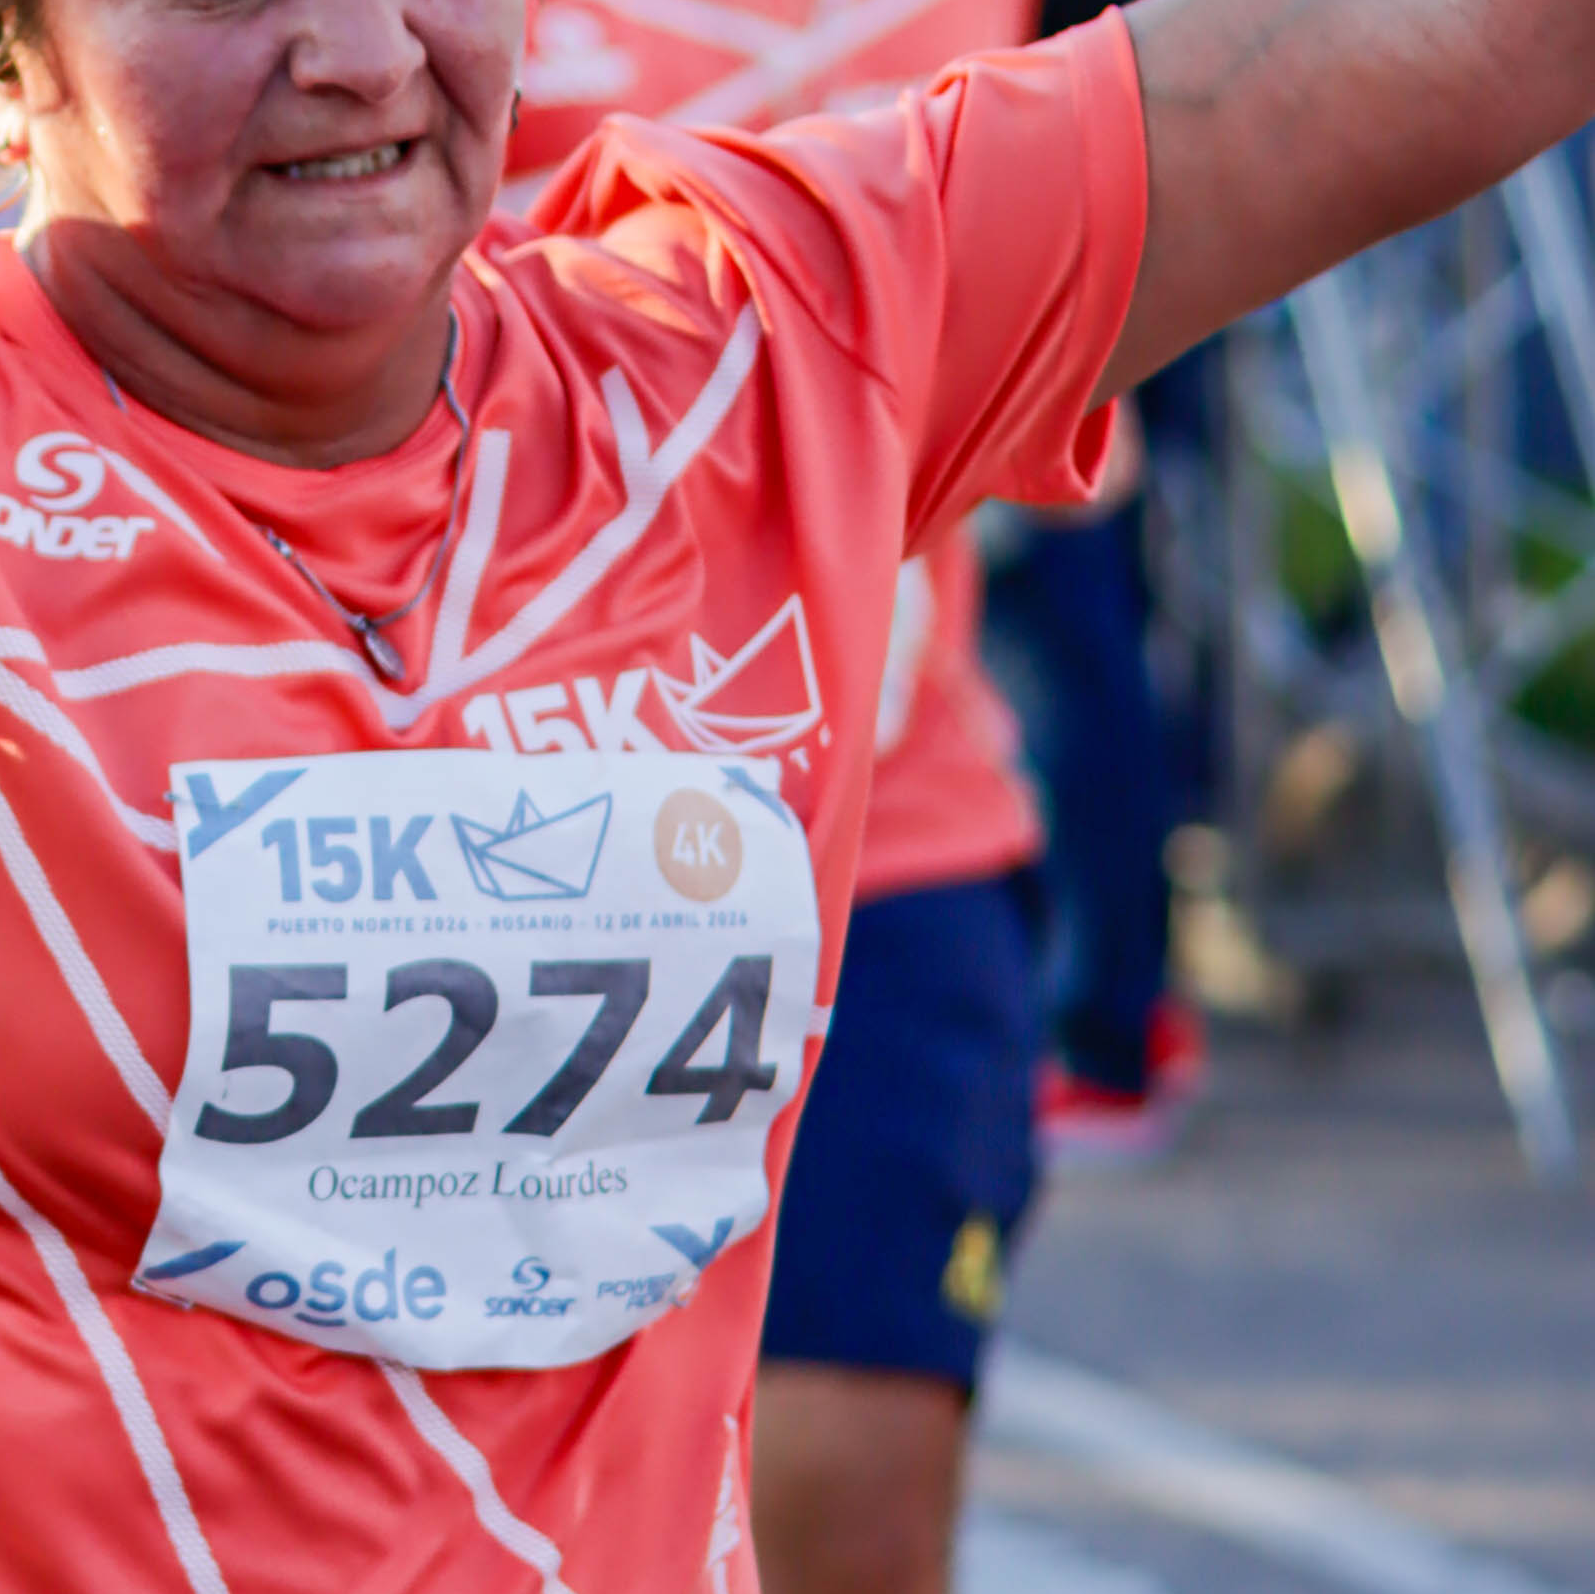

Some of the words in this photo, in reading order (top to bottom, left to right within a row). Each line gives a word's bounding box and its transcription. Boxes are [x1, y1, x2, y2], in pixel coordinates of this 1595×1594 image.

[462, 667, 671, 753] 15K
[261, 815, 438, 902] 15K
[671, 820, 727, 867] 4K
[268, 916, 345, 934] PUERTO
[352, 916, 415, 934] NORTE
[423, 915, 469, 933] 2026
[490, 913, 573, 931] ROSARIO
[595, 912, 614, 930] 12
[620, 912, 641, 930] DE
[649, 911, 701, 929] ABRIL
[194, 954, 777, 1144] 5274
[308, 1165, 479, 1208] Ocampoz
[491, 1159, 628, 1202] Lourdes
[245, 1248, 446, 1326] osde
